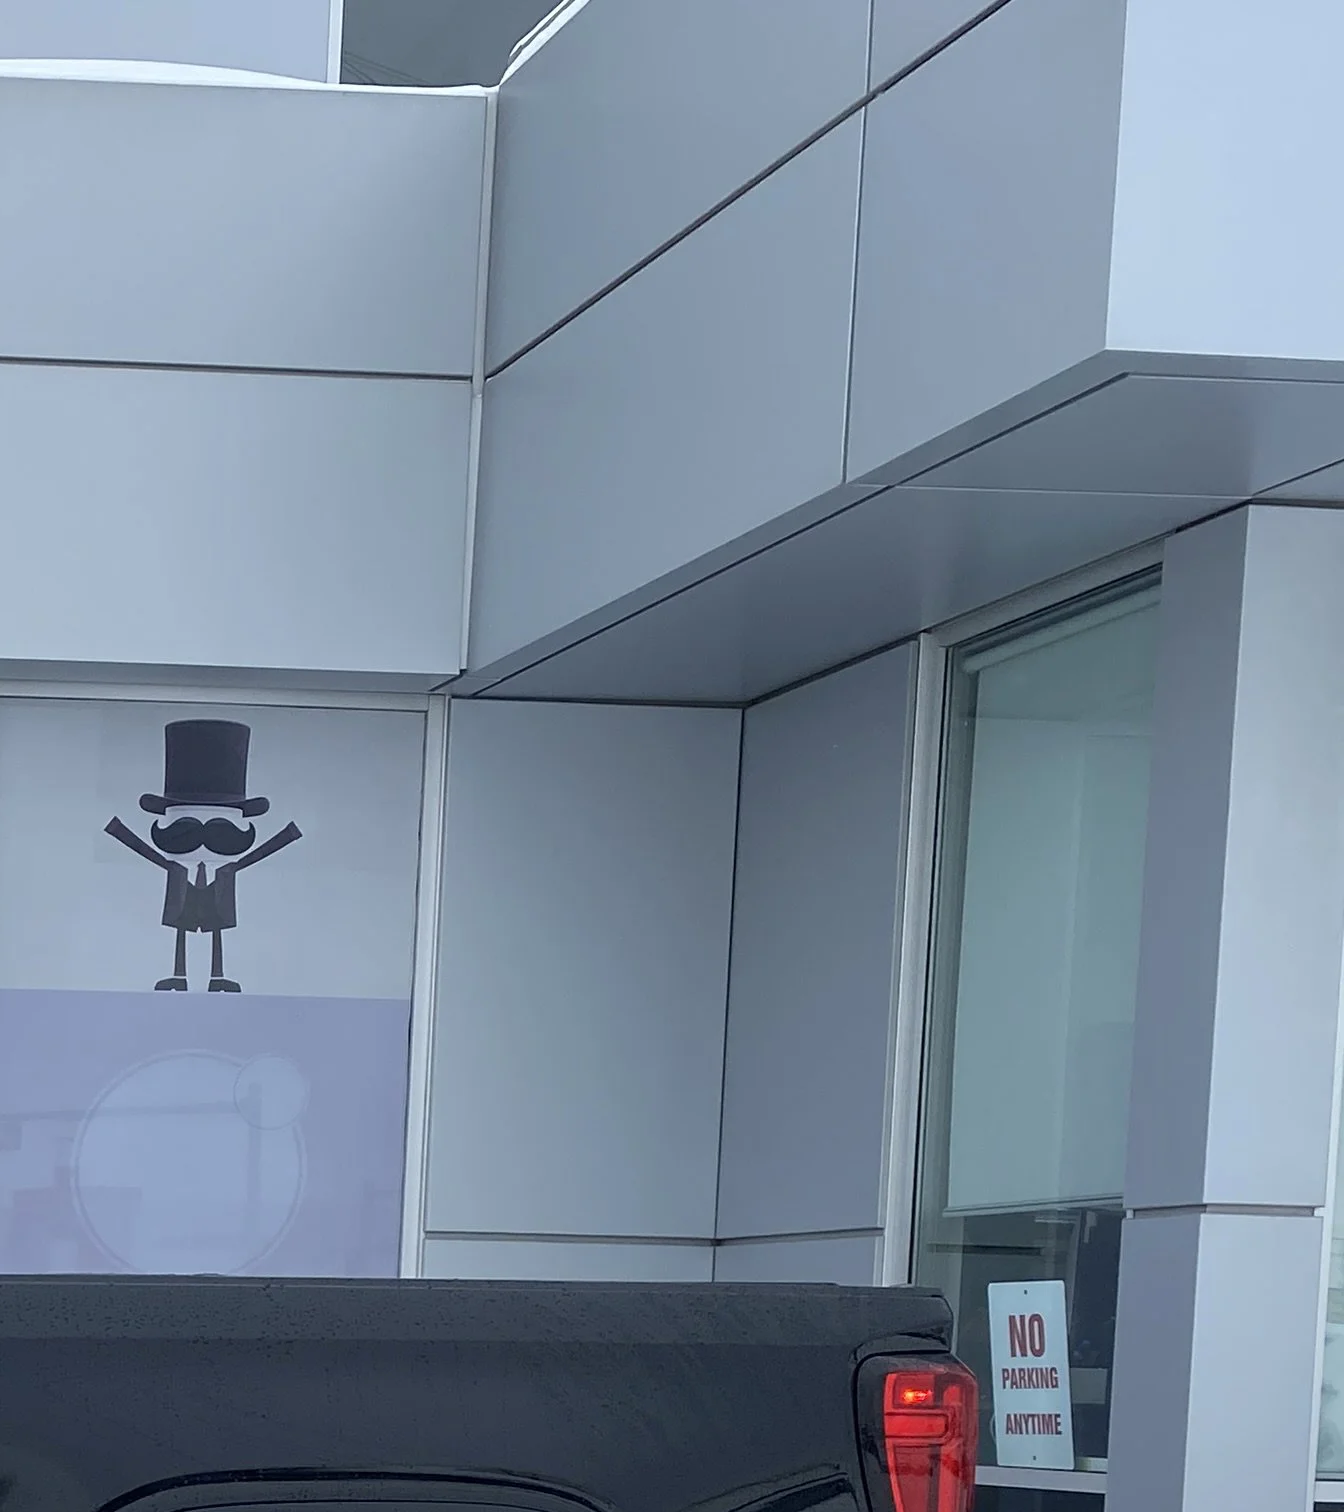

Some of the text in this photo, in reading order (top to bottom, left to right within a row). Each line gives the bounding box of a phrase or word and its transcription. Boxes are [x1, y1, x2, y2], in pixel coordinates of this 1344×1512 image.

[1008, 1313, 1046, 1358] NO
[1001, 1366, 1059, 1390] PARKING
[1005, 1413, 1063, 1436] ANYTIME
